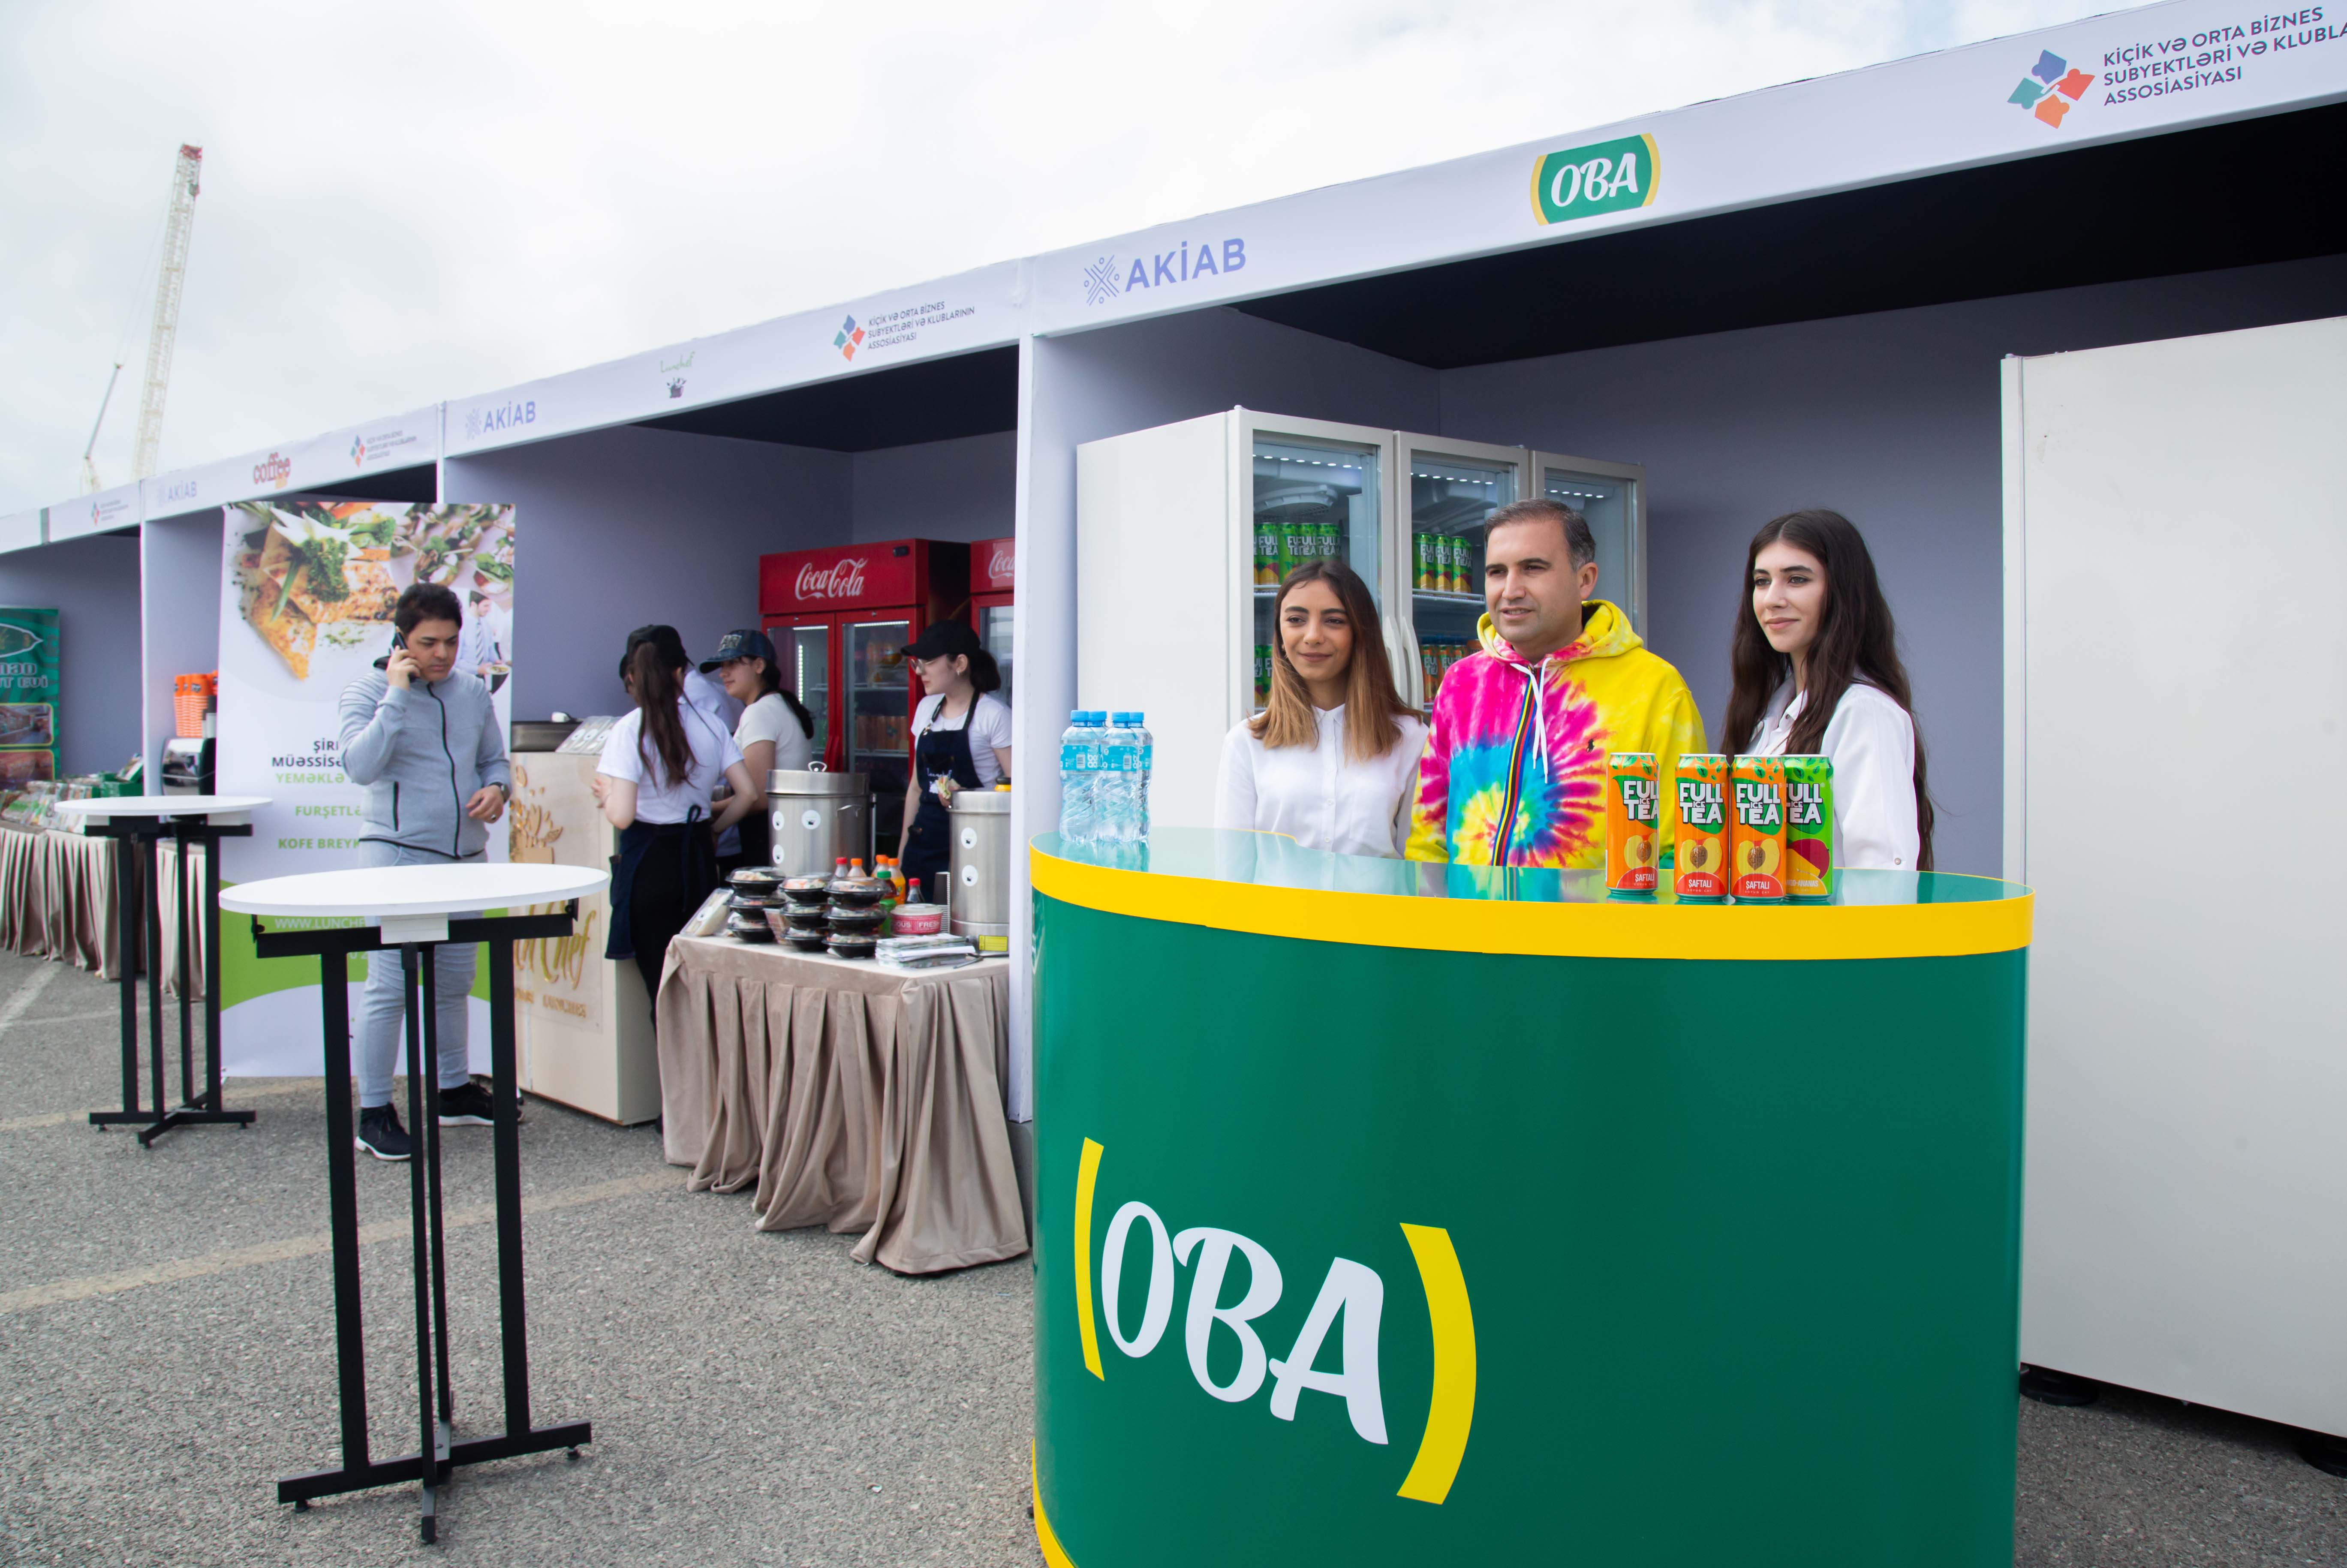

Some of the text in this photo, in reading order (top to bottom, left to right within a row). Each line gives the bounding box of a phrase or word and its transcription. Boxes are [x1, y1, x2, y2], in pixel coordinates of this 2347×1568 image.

[2104, 6, 2323, 66] KİÇİK VƏ ORTA BİZNES
[2104, 44, 2231, 86] SUBYEKTLƏRİ
[2236, 41, 2268, 58] VƏ
[2104, 66, 2242, 106] ASSOSİASİYASI
[1125, 238, 1246, 292] AKİAB
[888, 312, 898, 321] VƏ
[900, 308, 918, 319] ORTA
[921, 301, 945, 314] BİZNES
[915, 318, 925, 326] VƏ
[484, 400, 536, 433] AKİAB
[253, 452, 291, 485] coffee
[314, 738, 339, 753] ŞİR
[1679, 782, 1723, 803] FULL
[1736, 783, 1781, 804] FULL
[1786, 783, 1823, 803] ULL
[1679, 802, 1723, 824] TEA
[1736, 803, 1780, 825] TEA
[1786, 803, 1822, 824] EA
[278, 838, 313, 849] KOFE
